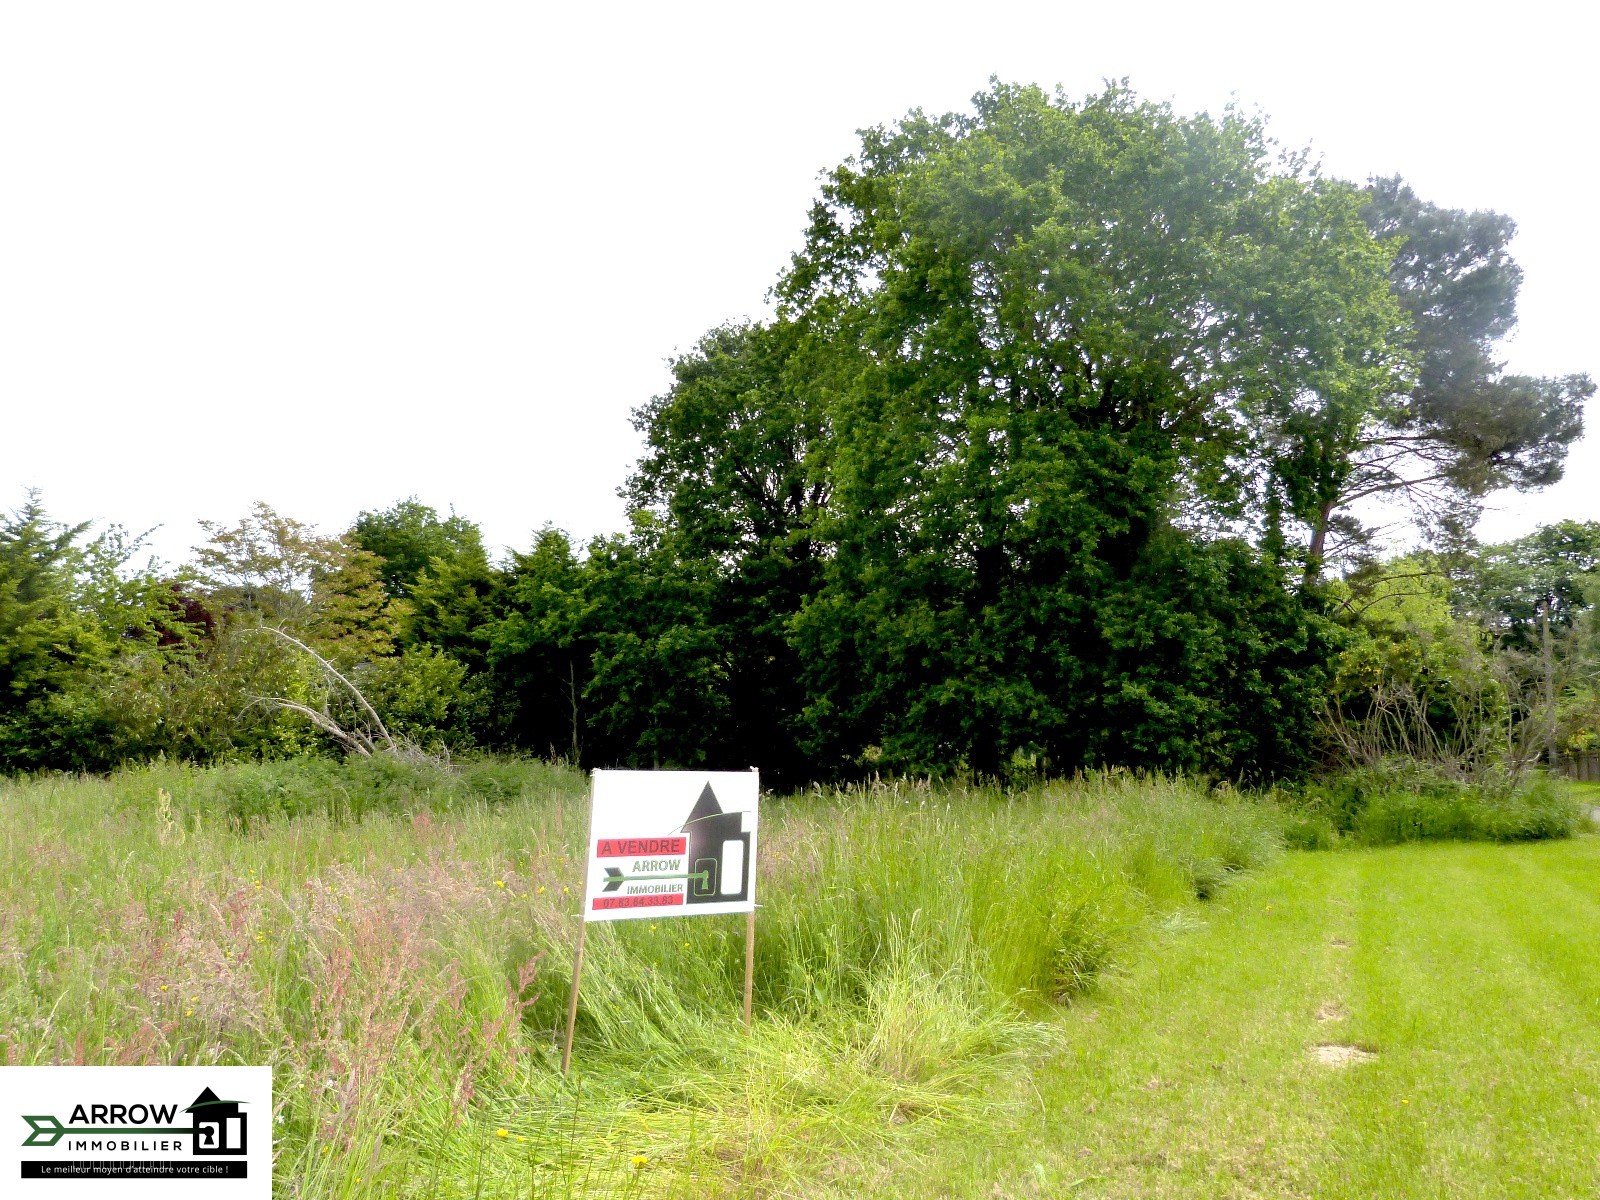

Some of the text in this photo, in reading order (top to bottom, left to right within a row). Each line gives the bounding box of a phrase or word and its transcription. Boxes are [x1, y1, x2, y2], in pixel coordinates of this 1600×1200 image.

[601, 839, 680, 855] A VENDRE
[632, 859, 681, 872] ARROW
[626, 883, 683, 895] IMMOBILIER
